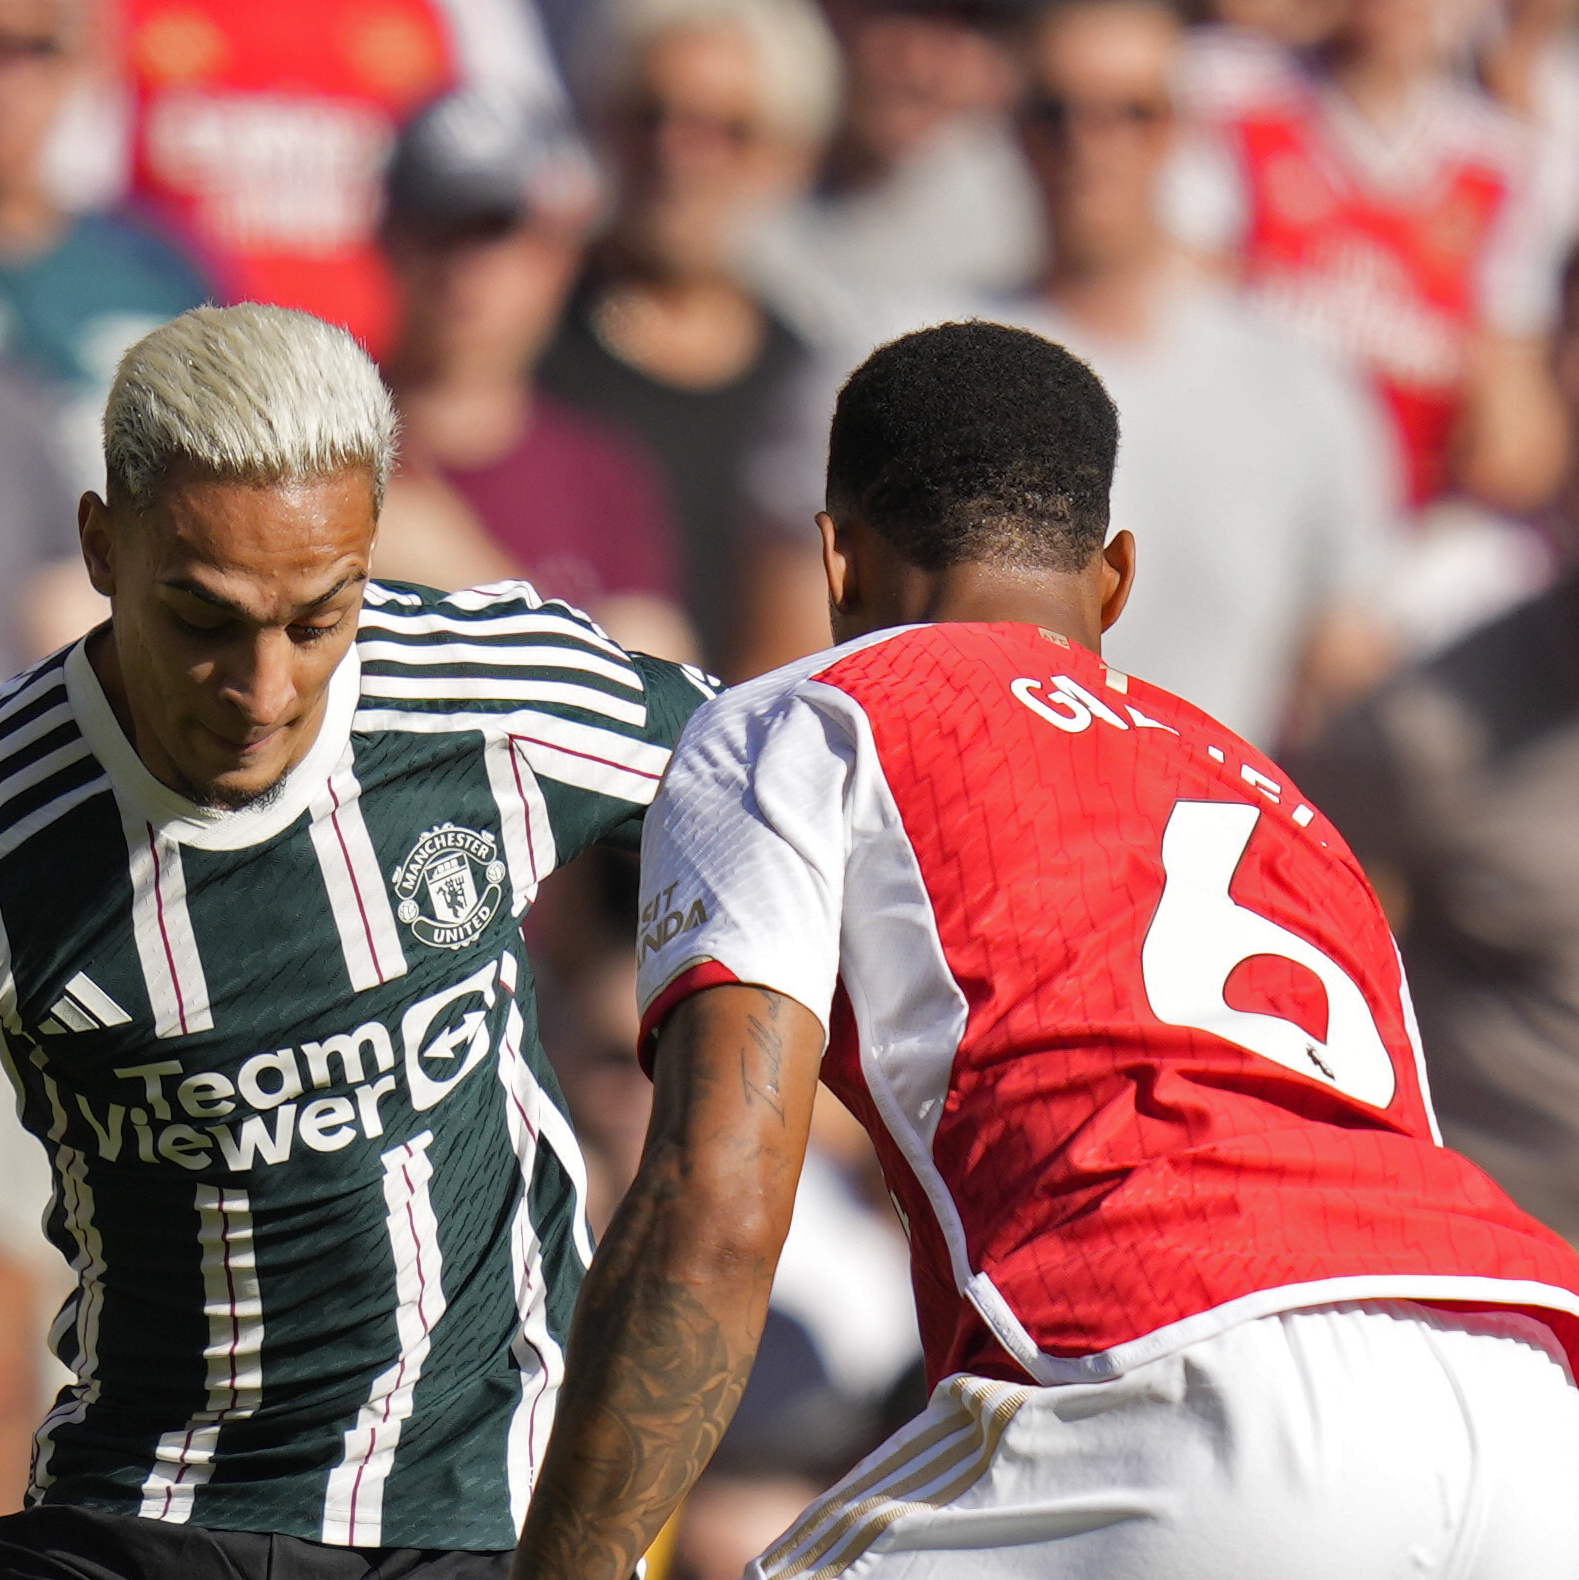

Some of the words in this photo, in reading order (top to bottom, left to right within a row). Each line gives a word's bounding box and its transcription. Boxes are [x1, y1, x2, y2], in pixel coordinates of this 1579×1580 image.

[401, 832, 490, 891] MANCHESTER
[433, 905, 491, 943] UNITED
[640, 880, 679, 933] SIT
[1141, 798, 1397, 1110] 6
[113, 1020, 396, 1121] Team
[74, 1074, 397, 1172] Viewer
